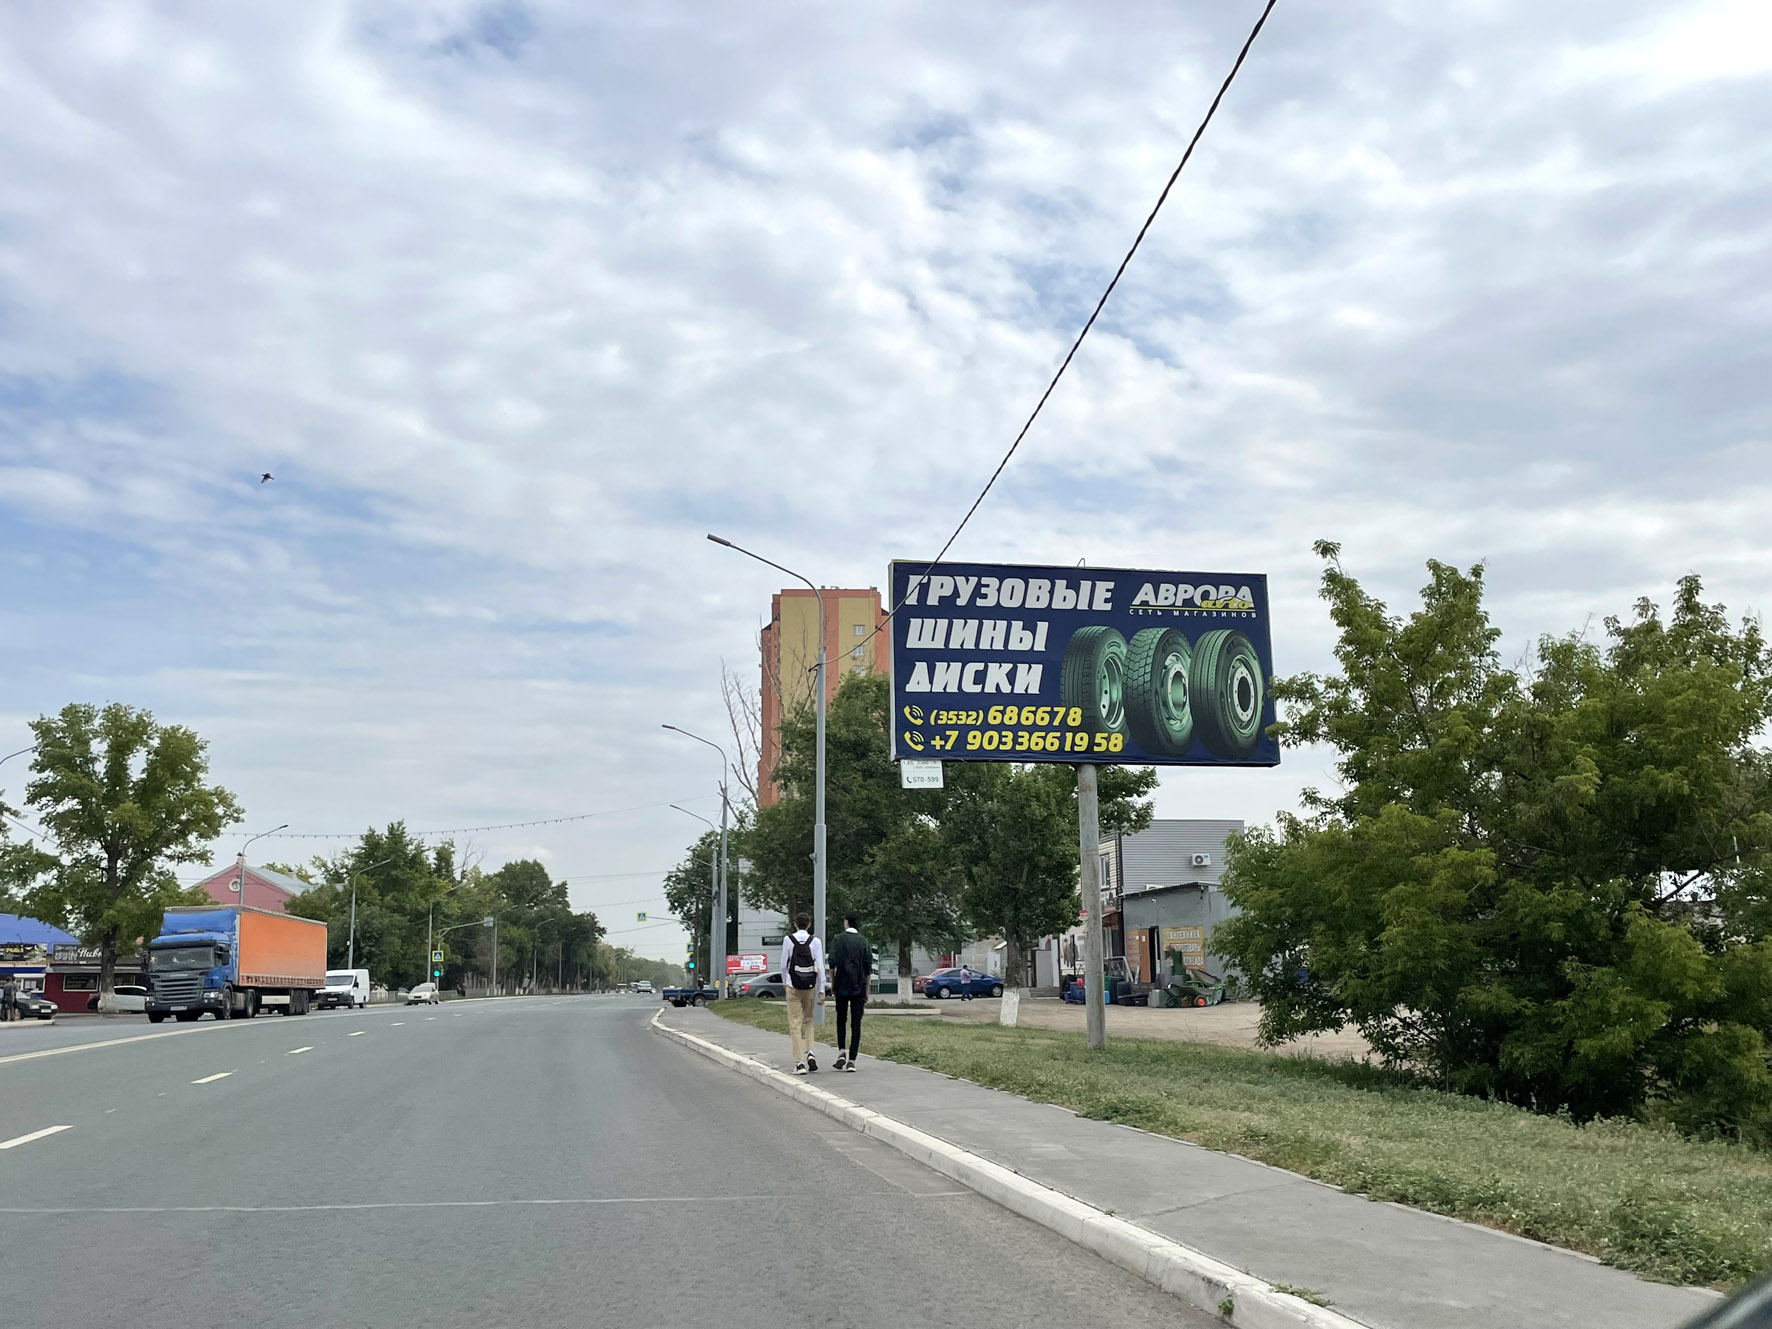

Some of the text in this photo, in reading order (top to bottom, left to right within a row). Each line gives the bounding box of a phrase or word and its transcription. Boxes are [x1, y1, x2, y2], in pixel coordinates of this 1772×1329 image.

[905, 575, 1115, 611] ГРУЗОВЫЕ
[1131, 582, 1255, 608] АВРОРА
[1129, 608, 1257, 618] СЕТЬ МАГАЗИНОВ
[906, 618, 1049, 651] ШИНЫ
[905, 661, 1043, 694] ДИСКИ
[930, 705, 1082, 727] (3532) 686678
[931, 730, 959, 750] +7
